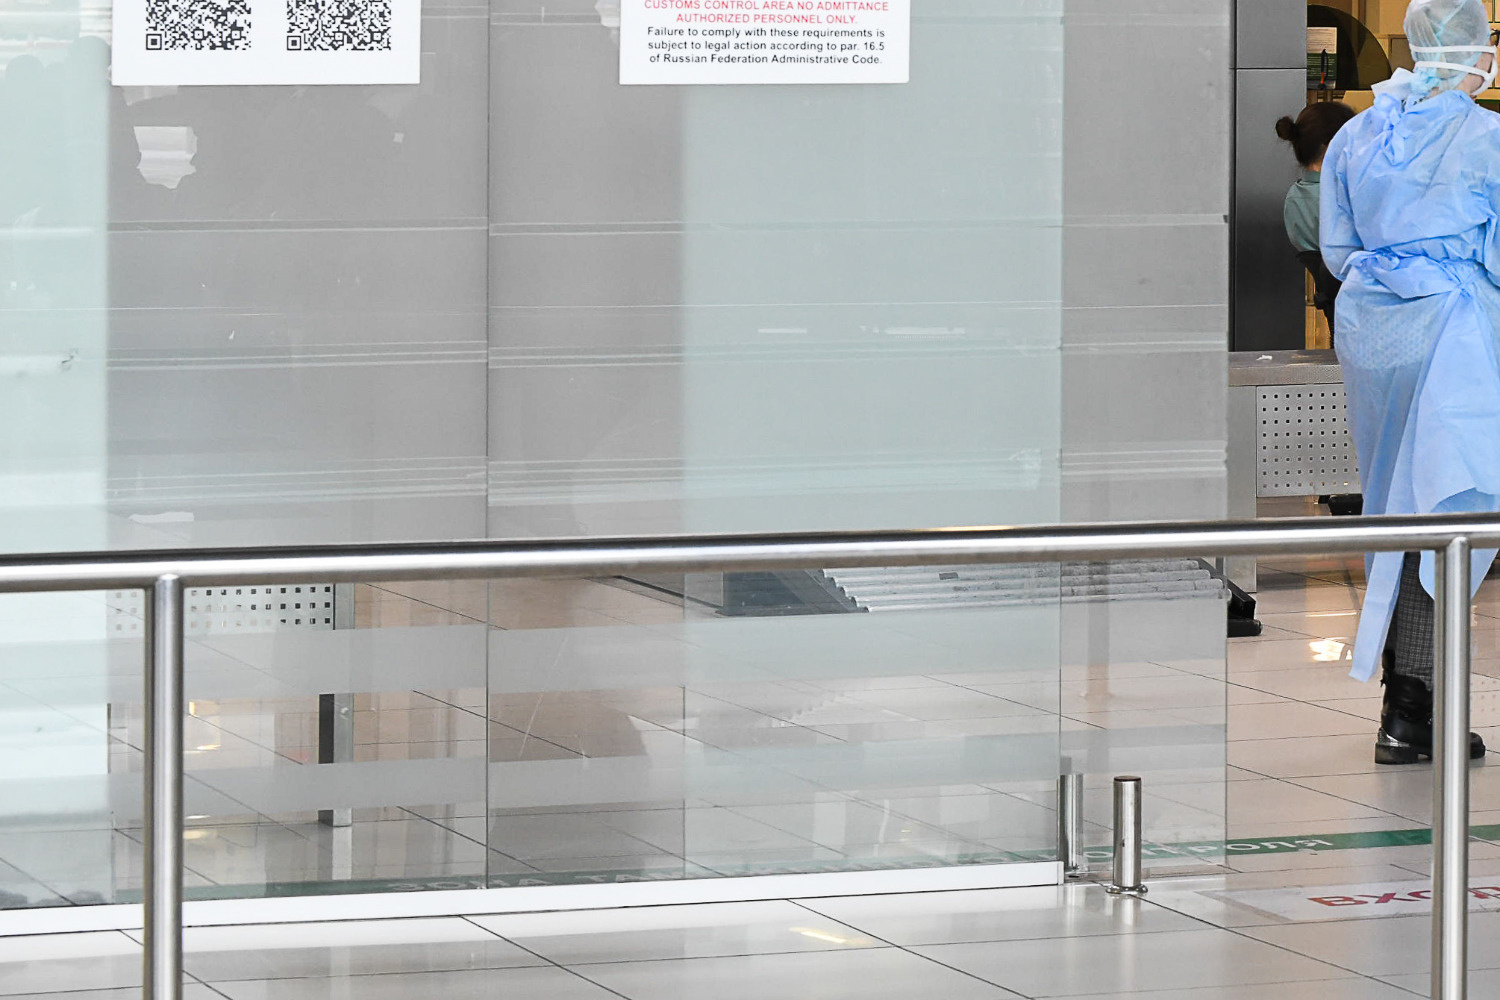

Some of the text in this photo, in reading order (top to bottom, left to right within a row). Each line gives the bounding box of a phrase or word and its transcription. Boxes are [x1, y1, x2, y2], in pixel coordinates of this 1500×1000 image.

[644, 0, 888, 11] CUSTOMS CONTROL AREA NO ADMITTANCE
[676, 14, 858, 24] AUTHORIZED PERSONNEL ONLY.
[647, 27, 885, 38] Failure to comply with these requirements is
[647, 41, 885, 53] subject to legal action according to par. 16.5
[649, 54, 883, 64] of Russian Federation Administrative Code.
